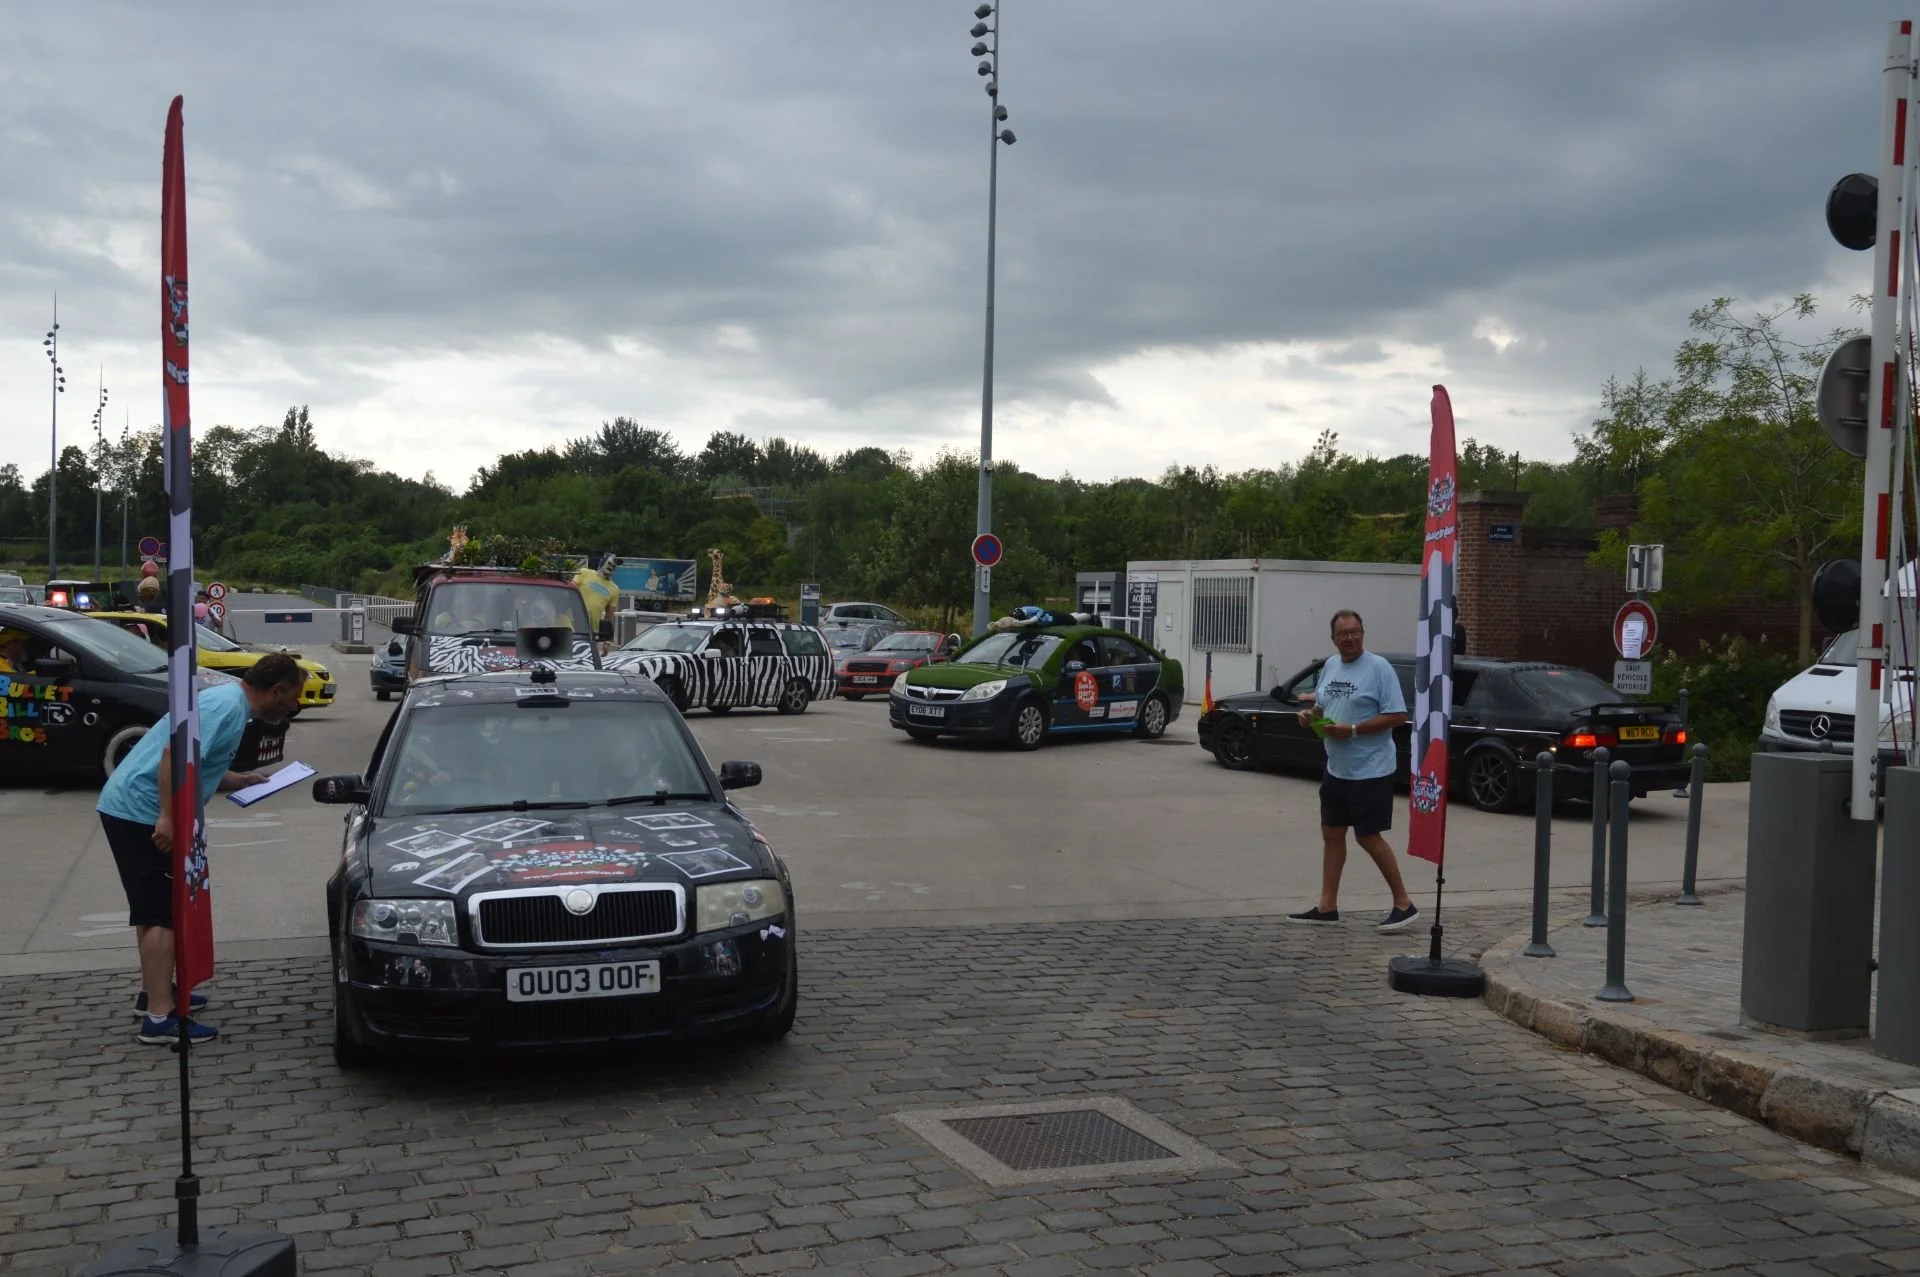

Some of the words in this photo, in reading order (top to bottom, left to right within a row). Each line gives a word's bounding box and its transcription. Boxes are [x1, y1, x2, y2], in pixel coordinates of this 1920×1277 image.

[0, 675, 74, 702] BULLET
[519, 968, 591, 996] OU03
[600, 964, 650, 991] OOF
